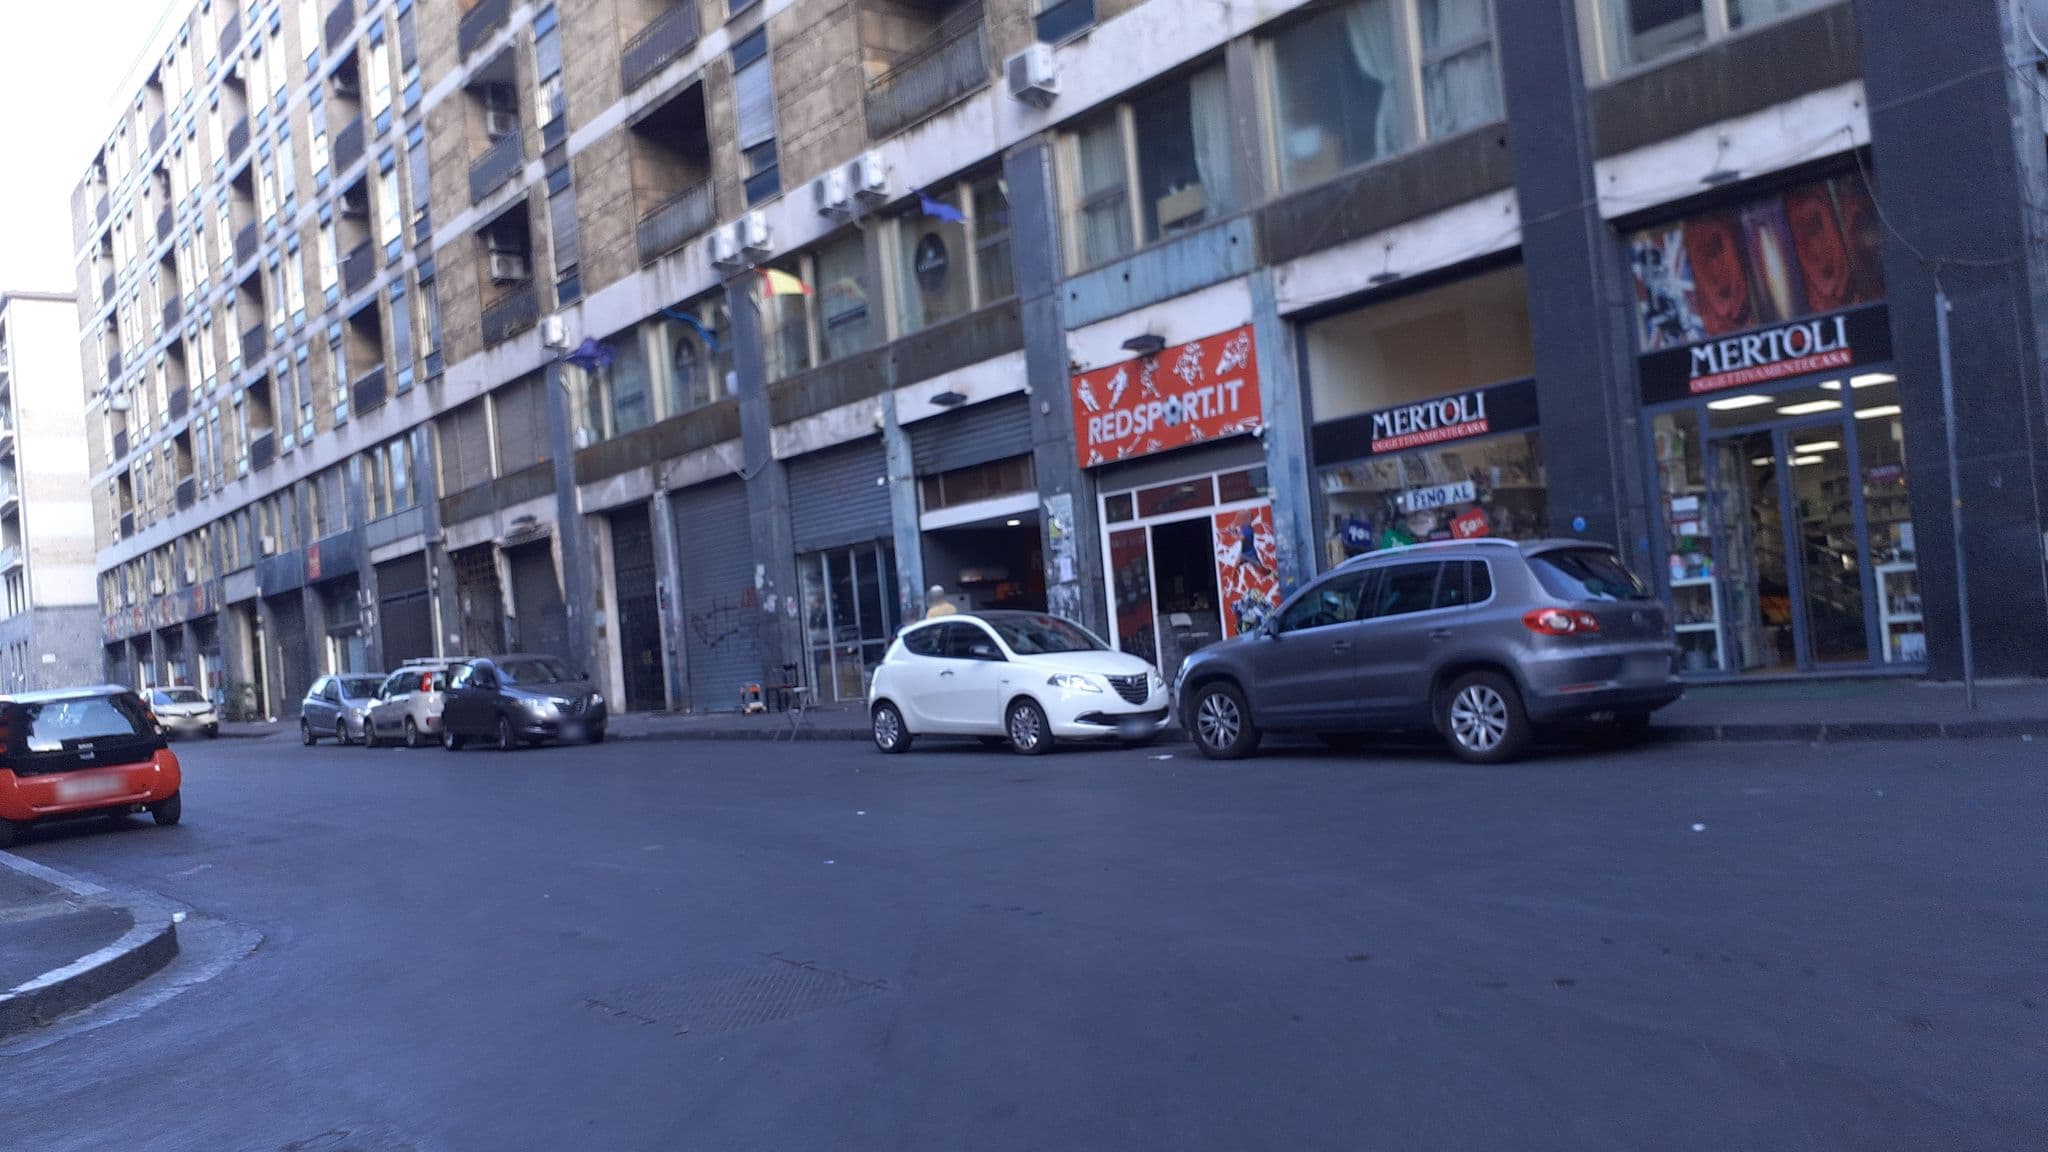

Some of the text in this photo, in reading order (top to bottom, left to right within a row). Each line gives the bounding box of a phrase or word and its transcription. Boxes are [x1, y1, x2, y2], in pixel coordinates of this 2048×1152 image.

[1690, 316, 1848, 377] MERTOLI
[1087, 378, 1244, 446] REDSPORT.IT
[1371, 391, 1486, 441] MERTOLI
